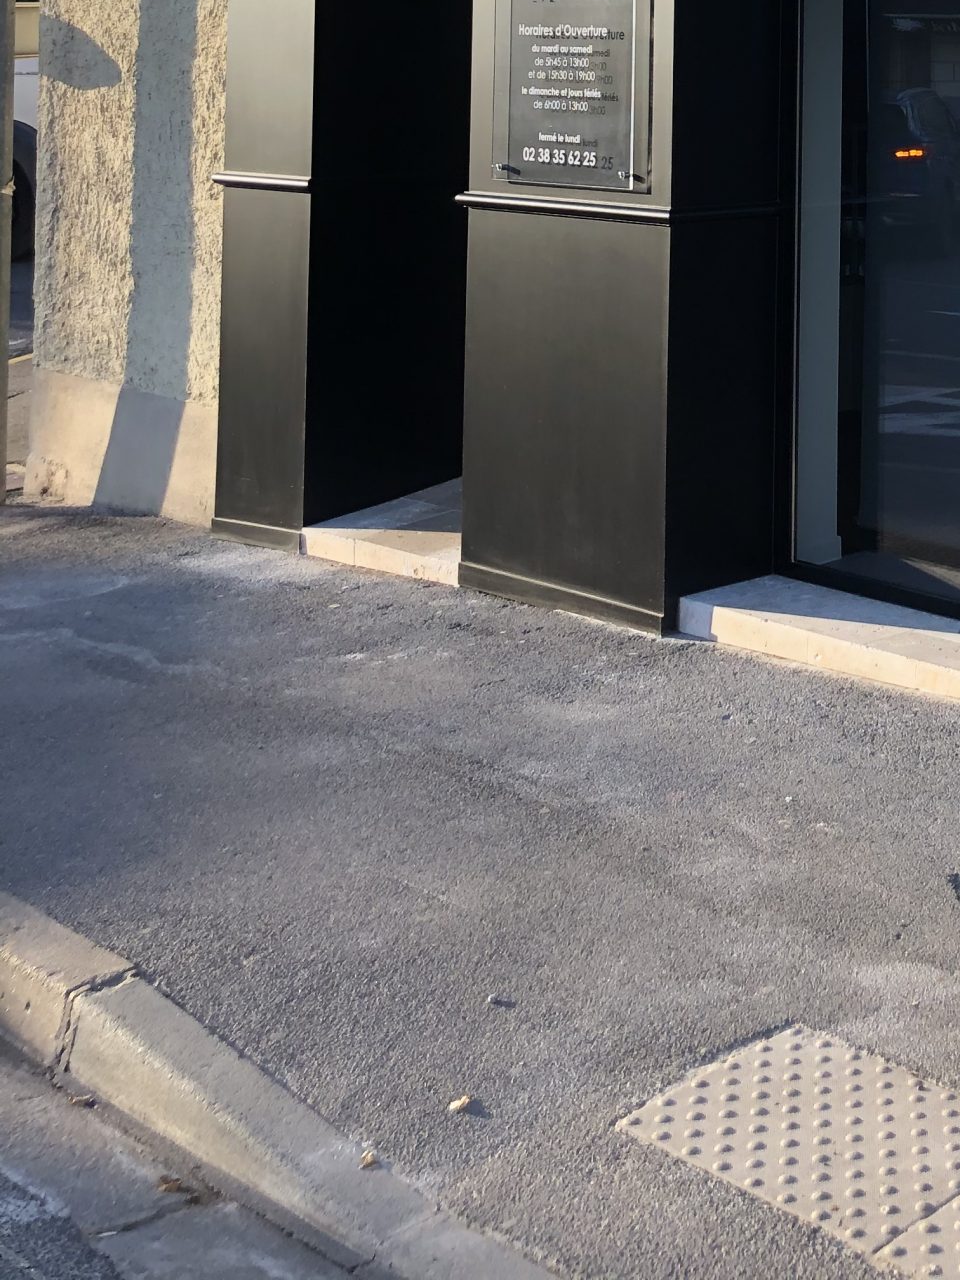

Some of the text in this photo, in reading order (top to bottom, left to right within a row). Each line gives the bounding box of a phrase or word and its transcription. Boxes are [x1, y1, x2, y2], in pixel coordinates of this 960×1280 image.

[519, 24, 608, 37] Horaires d'Ouverture
[531, 44, 593, 54] du mardi au samedi
[534, 57, 544, 66] de
[545, 57, 561, 67] 5h45
[569, 57, 589, 68] 13h00
[537, 70, 546, 80] de
[575, 71, 596, 81] 19h00
[529, 86, 560, 96] dimanche
[533, 100, 543, 109] de
[568, 100, 588, 112] 13h00
[538, 132, 557, 142] fermé
[565, 134, 581, 144] lundi
[522, 146, 597, 166] 02 38 35 62 25
